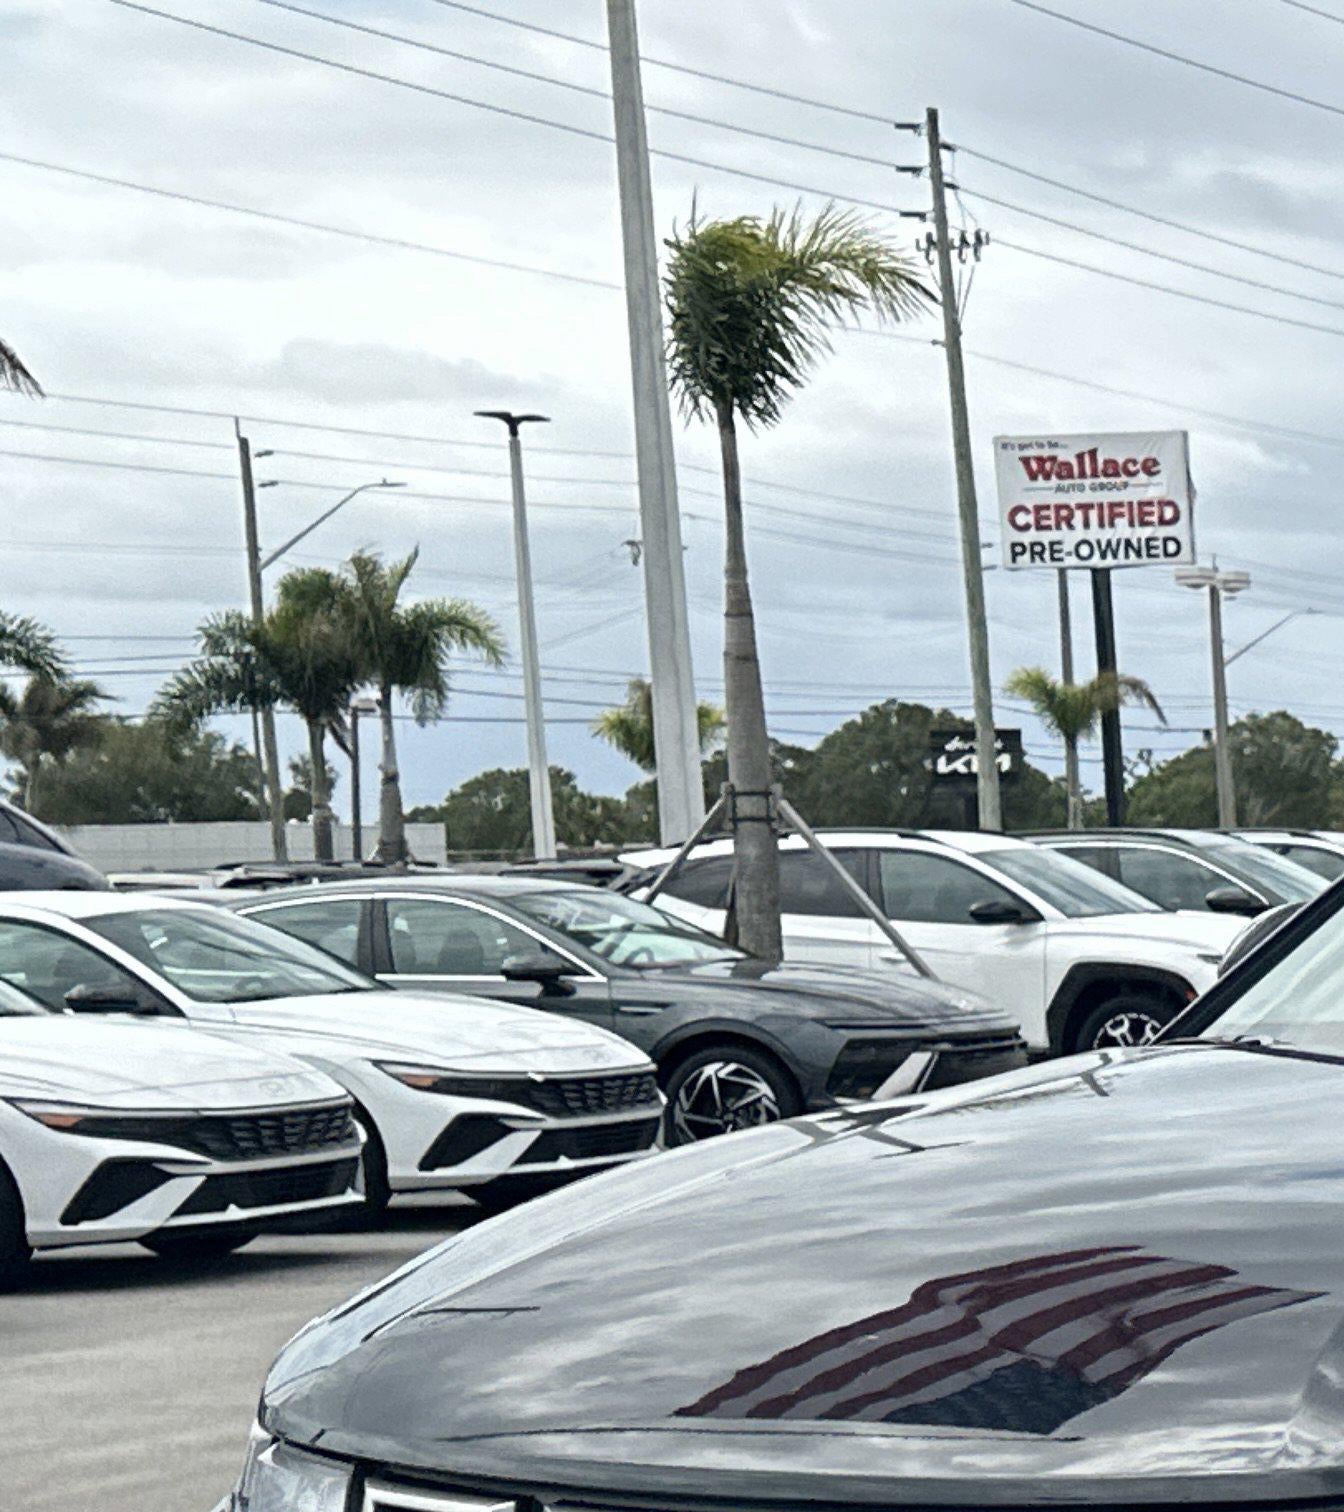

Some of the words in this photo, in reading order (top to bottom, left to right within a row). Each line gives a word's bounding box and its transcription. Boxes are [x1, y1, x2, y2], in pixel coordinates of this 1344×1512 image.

[1018, 447, 1161, 481] Wallace
[1055, 483, 1086, 494] AUTO
[1089, 481, 1129, 492] GROUP
[1008, 500, 1181, 533] CERTIFIED
[1010, 536, 1182, 563] PRE-OWNED
